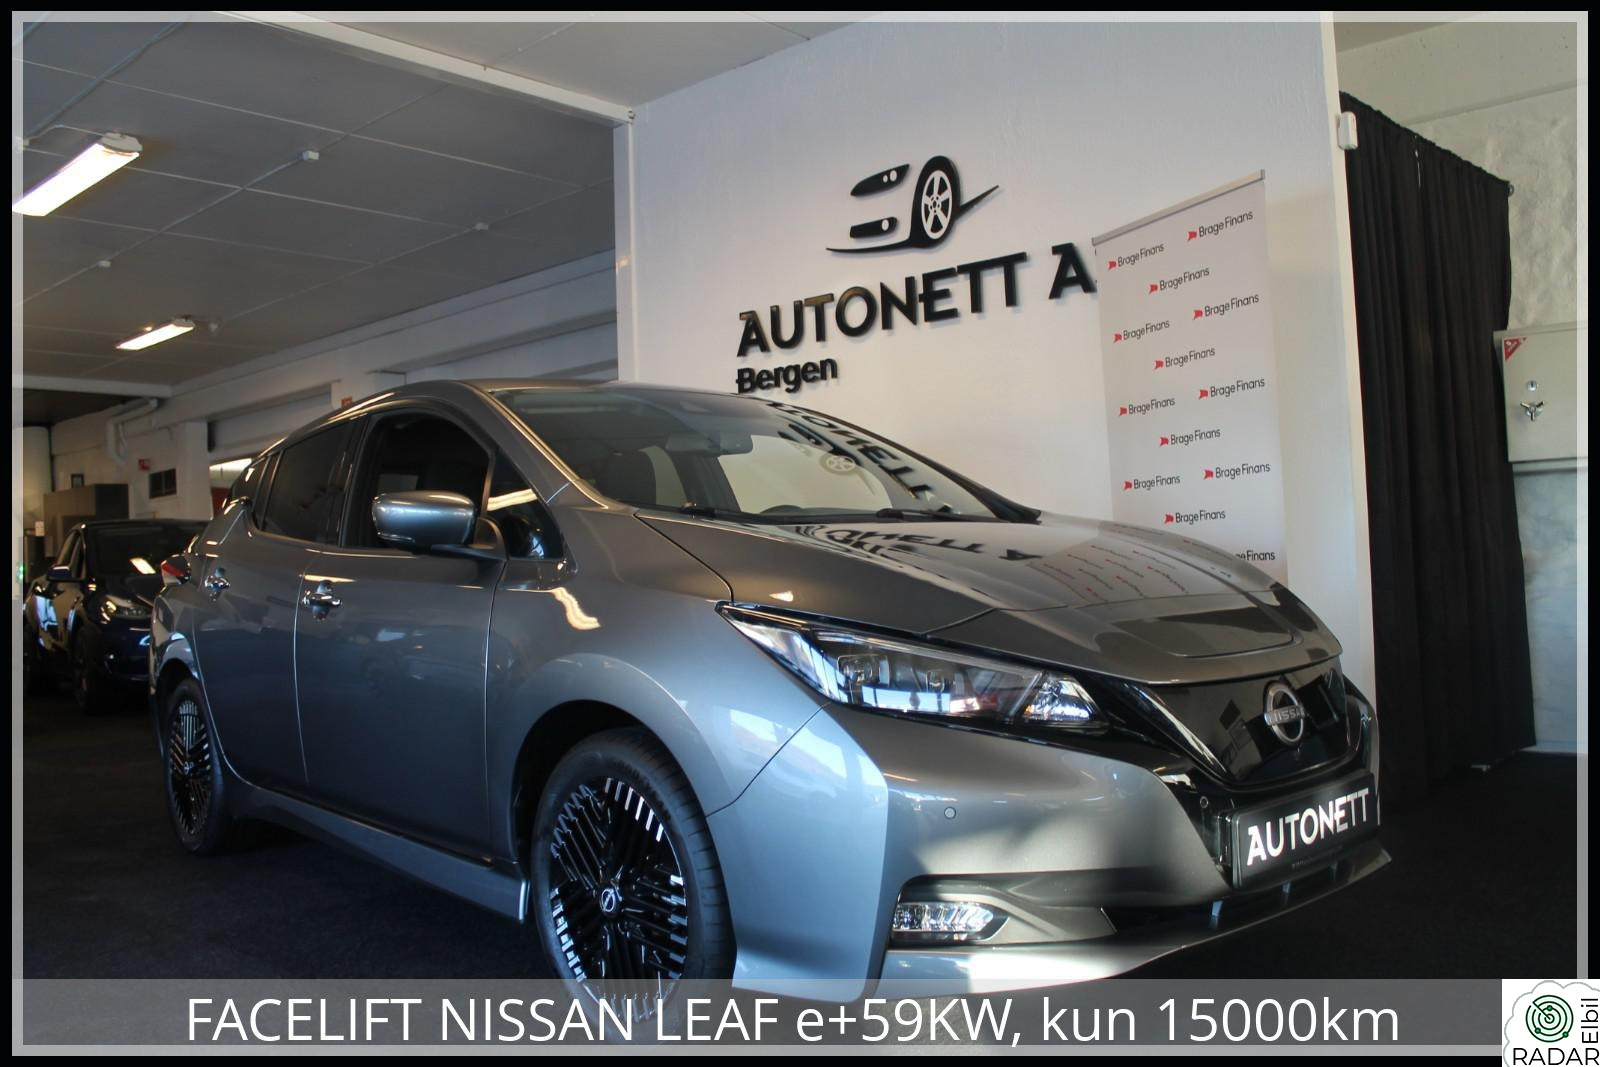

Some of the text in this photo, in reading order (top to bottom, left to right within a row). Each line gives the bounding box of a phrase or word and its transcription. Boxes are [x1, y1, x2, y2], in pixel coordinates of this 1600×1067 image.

[1199, 211, 1254, 238] Brage Finans
[1117, 243, 1165, 268] Brage Finans
[1159, 267, 1210, 292] Brage Finans
[737, 242, 1098, 357] AUTONETT A
[1204, 293, 1260, 317] Brage Finans
[1123, 319, 1170, 342] Brage Finans
[1165, 346, 1216, 369] Brage Finans
[736, 357, 839, 394] Bergen
[1210, 377, 1265, 398] Brage Finans
[1128, 397, 1176, 416] Brage Finans
[1170, 427, 1221, 447] Brage Finans
[1133, 474, 1181, 491] Brage Finans
[1215, 462, 1271, 480] Brage Finans
[1175, 509, 1226, 526] Brage Finans
[1246, 549, 1276, 561] Finans
[1247, 788, 1369, 866] AUTONETT
